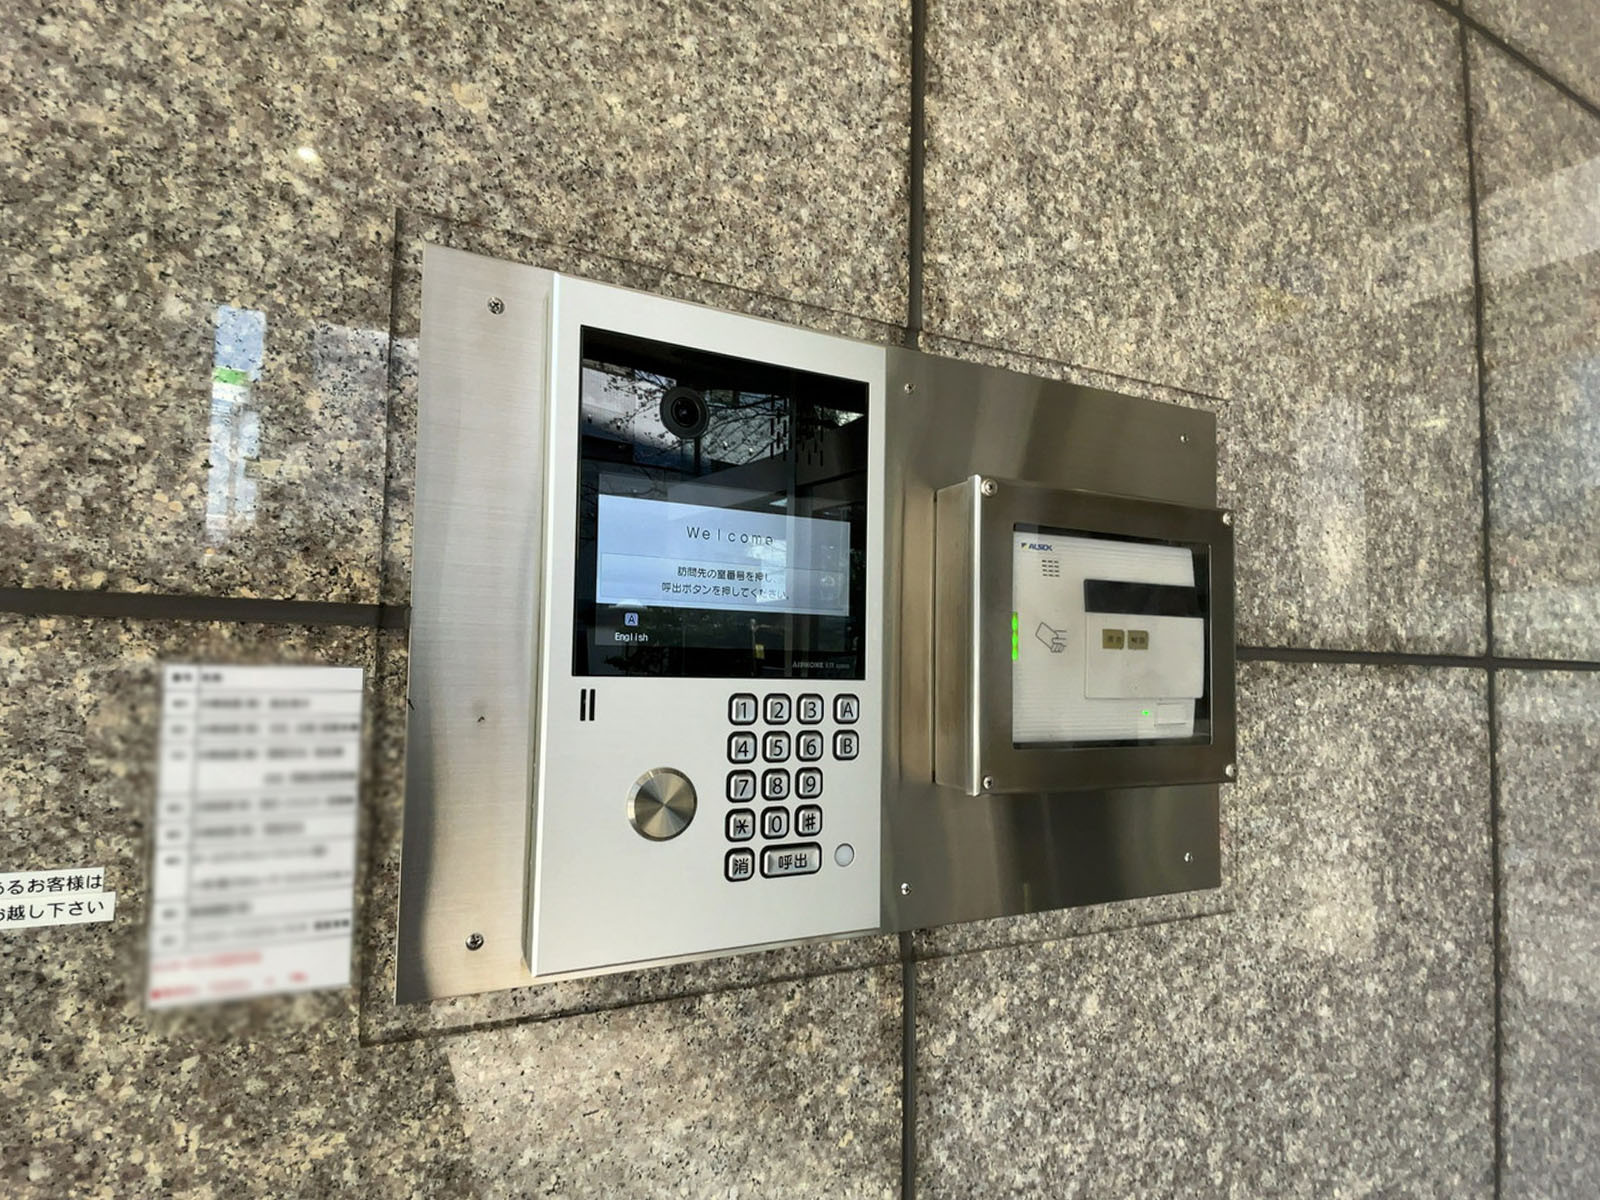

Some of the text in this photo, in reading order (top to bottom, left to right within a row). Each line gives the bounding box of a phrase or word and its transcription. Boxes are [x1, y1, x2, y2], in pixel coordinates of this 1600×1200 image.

[686, 525, 774, 546] Welcome
[614, 632, 649, 642] English
[774, 701, 784, 719] 2
[807, 701, 817, 718] 3
[843, 702, 854, 718] A
[737, 738, 853, 757] 4 5 6 B
[738, 776, 816, 796] 7 8 9
[771, 815, 782, 833] 0
[734, 853, 808, 875] 消 呼出
